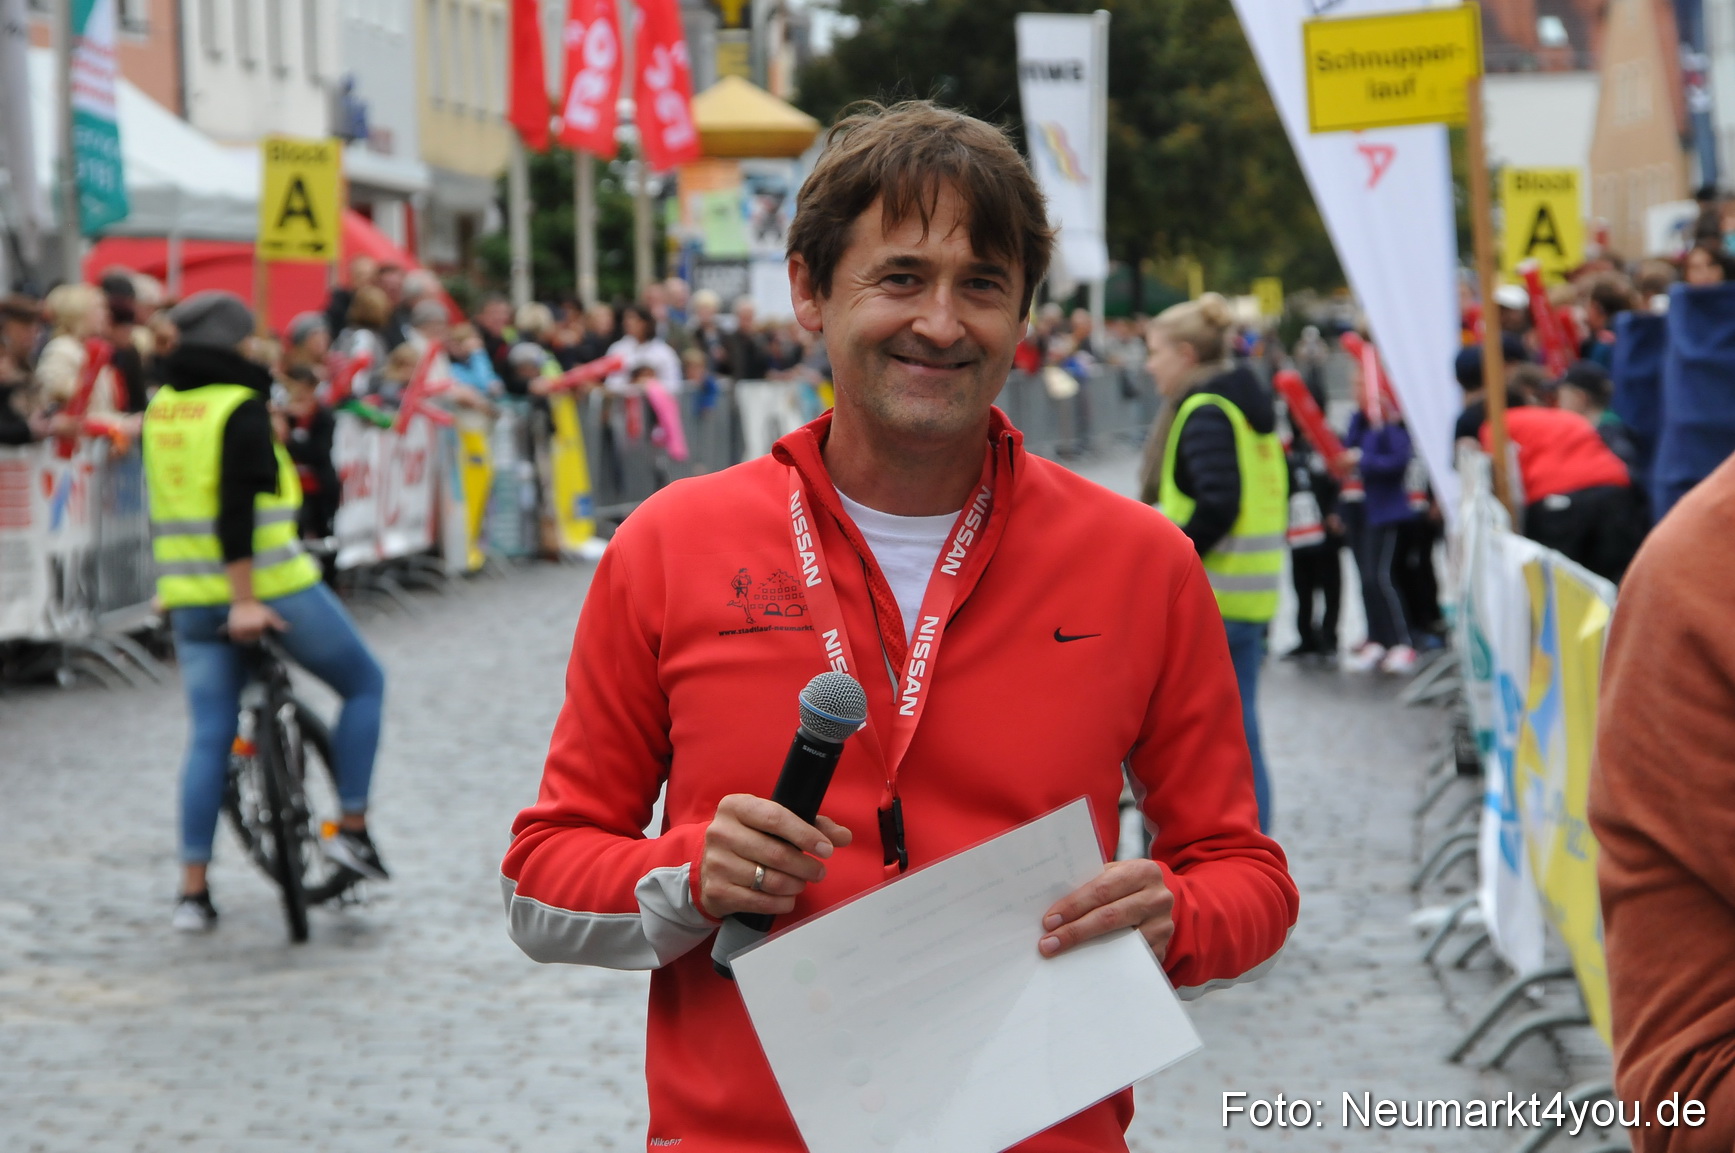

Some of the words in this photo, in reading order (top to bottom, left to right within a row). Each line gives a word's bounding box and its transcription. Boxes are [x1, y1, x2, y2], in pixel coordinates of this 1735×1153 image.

[1316, 44, 1466, 74] Schnupper-
[1367, 75, 1416, 100] lauf
[274, 176, 319, 230] A
[1522, 205, 1566, 256] A
[790, 489, 822, 588] NISSAN
[940, 485, 992, 577] NISSAN
[718, 625, 815, 636] www.stadtlauf-neumarkt.
[899, 615, 940, 716] NISSAN
[802, 744, 828, 758] SHURE
